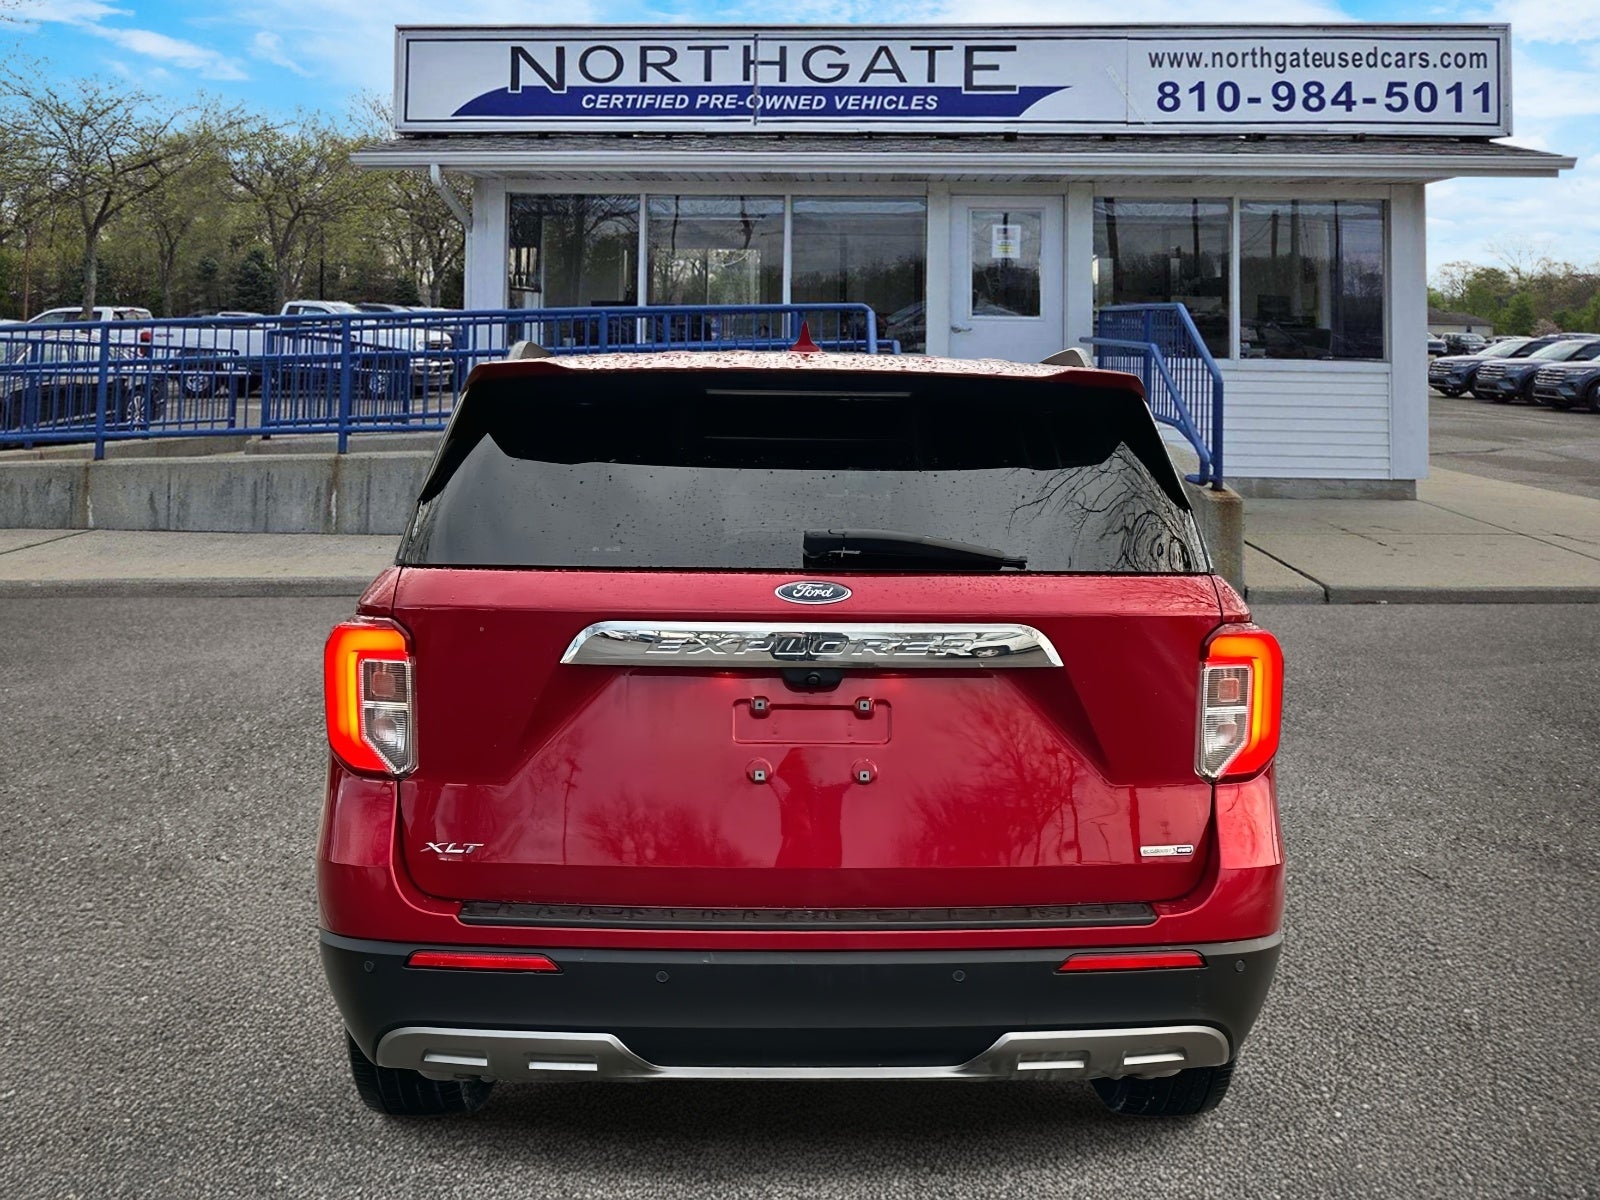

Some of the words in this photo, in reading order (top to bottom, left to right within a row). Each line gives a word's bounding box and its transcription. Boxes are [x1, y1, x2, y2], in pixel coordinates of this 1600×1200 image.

[510, 44, 1017, 92] NORTHGATE
[1148, 46, 1488, 74] www.northgateusedcars.com
[581, 93, 690, 110] CERTIFIED
[695, 93, 826, 111] PRE-OWNED
[834, 94, 939, 111] VEHICLES
[1156, 79, 1491, 113] 810-984-5011
[793, 583, 834, 598] Ford
[645, 635, 975, 656] EXPLORER
[420, 842, 485, 854] XLT
